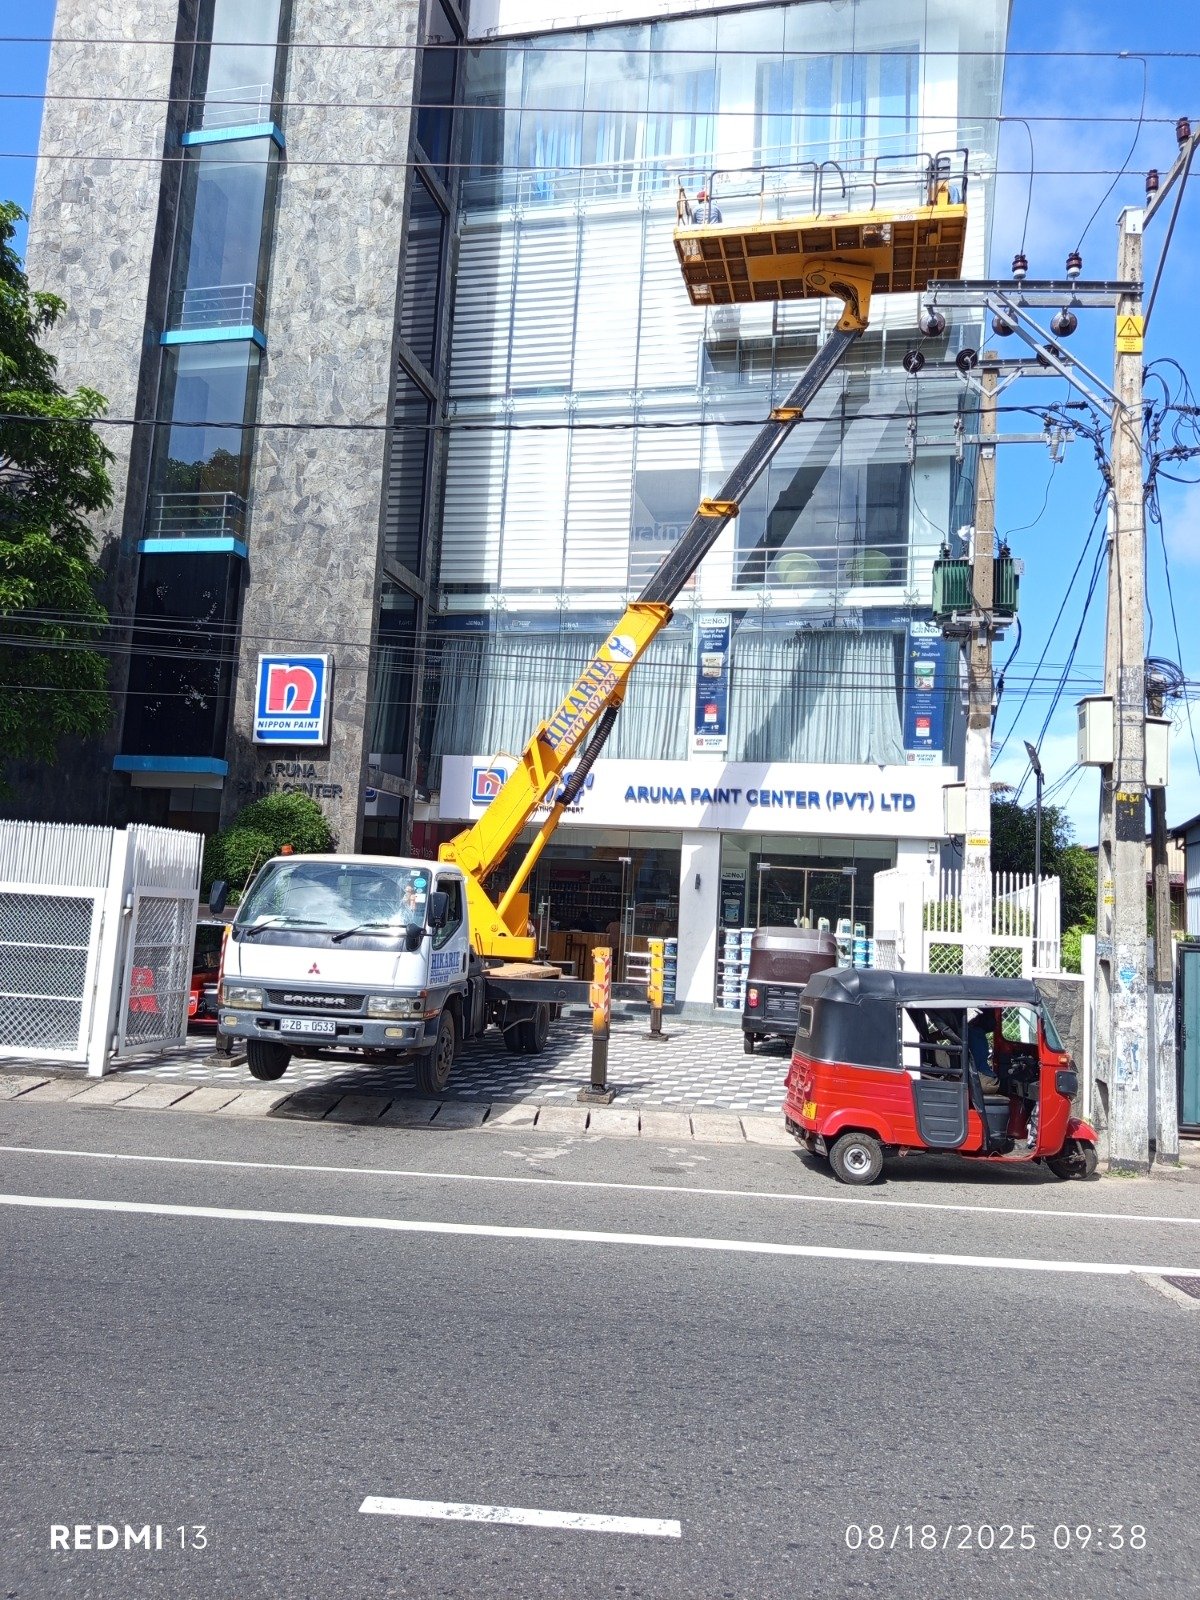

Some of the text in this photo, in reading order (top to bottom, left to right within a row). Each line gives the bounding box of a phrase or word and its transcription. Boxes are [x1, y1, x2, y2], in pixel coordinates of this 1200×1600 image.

[712, 617, 727, 625] No.1
[539, 657, 612, 749] HIKARIE
[258, 721, 319, 729] NIPPON PAINT
[564, 716, 588, 746] 0712
[585, 695, 604, 717] 102
[264, 763, 317, 778] ARUNA
[624, 785, 916, 812] ARUNA PAINT CENTER (PVT) LTD
[431, 951, 460, 969] HIKARIE
[283, 994, 347, 1006] CANTER
[289, 1020, 302, 1030] ZB
[311, 1021, 335, 1032] 0533
